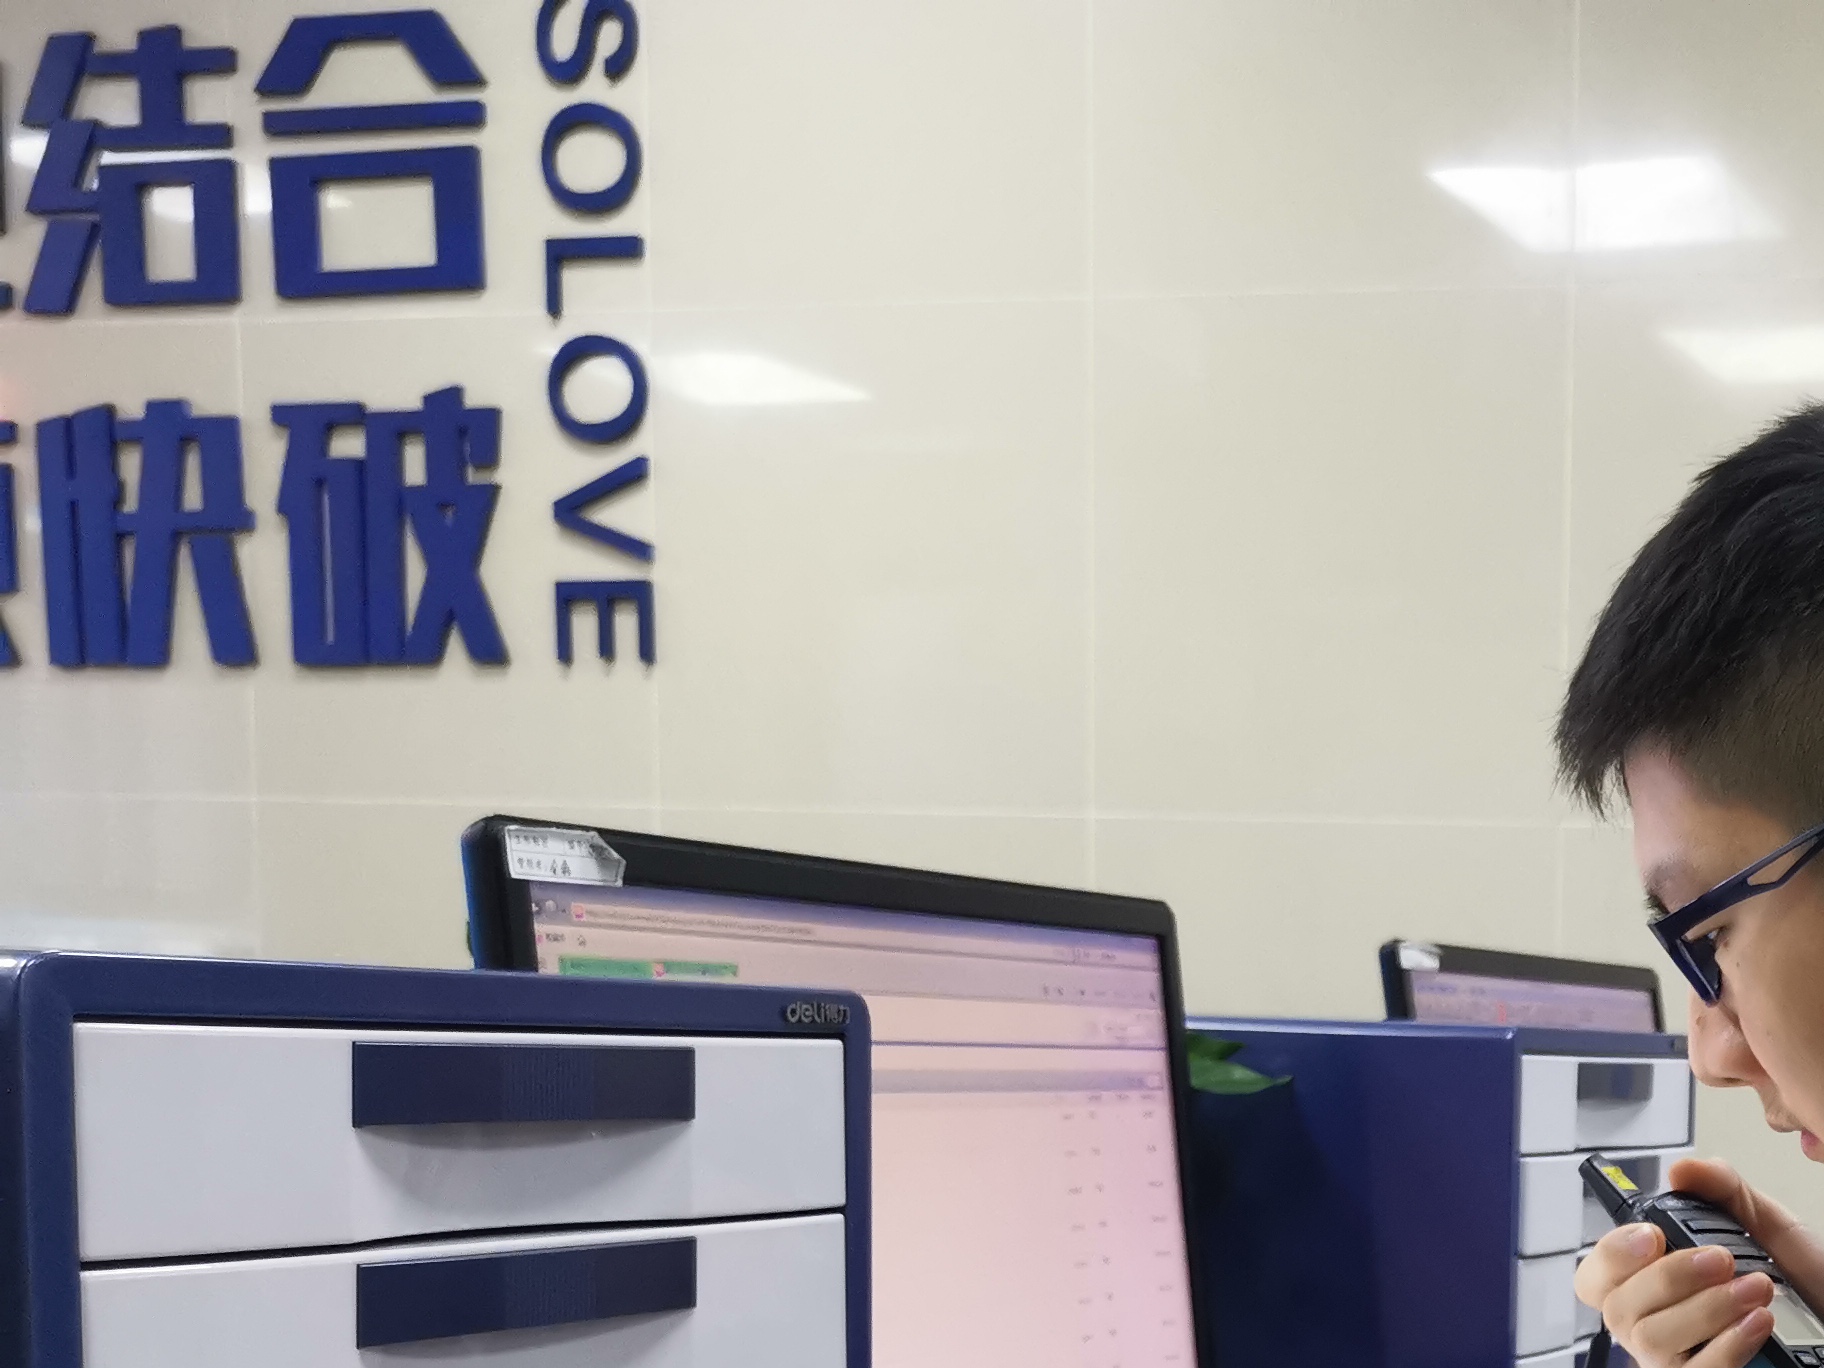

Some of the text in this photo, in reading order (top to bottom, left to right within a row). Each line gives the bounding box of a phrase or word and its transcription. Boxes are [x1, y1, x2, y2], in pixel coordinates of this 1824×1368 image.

[0, 10, 488, 316] 结合
[536, 0, 656, 668] SOLOVE
[0, 386, 510, 668] 快破
